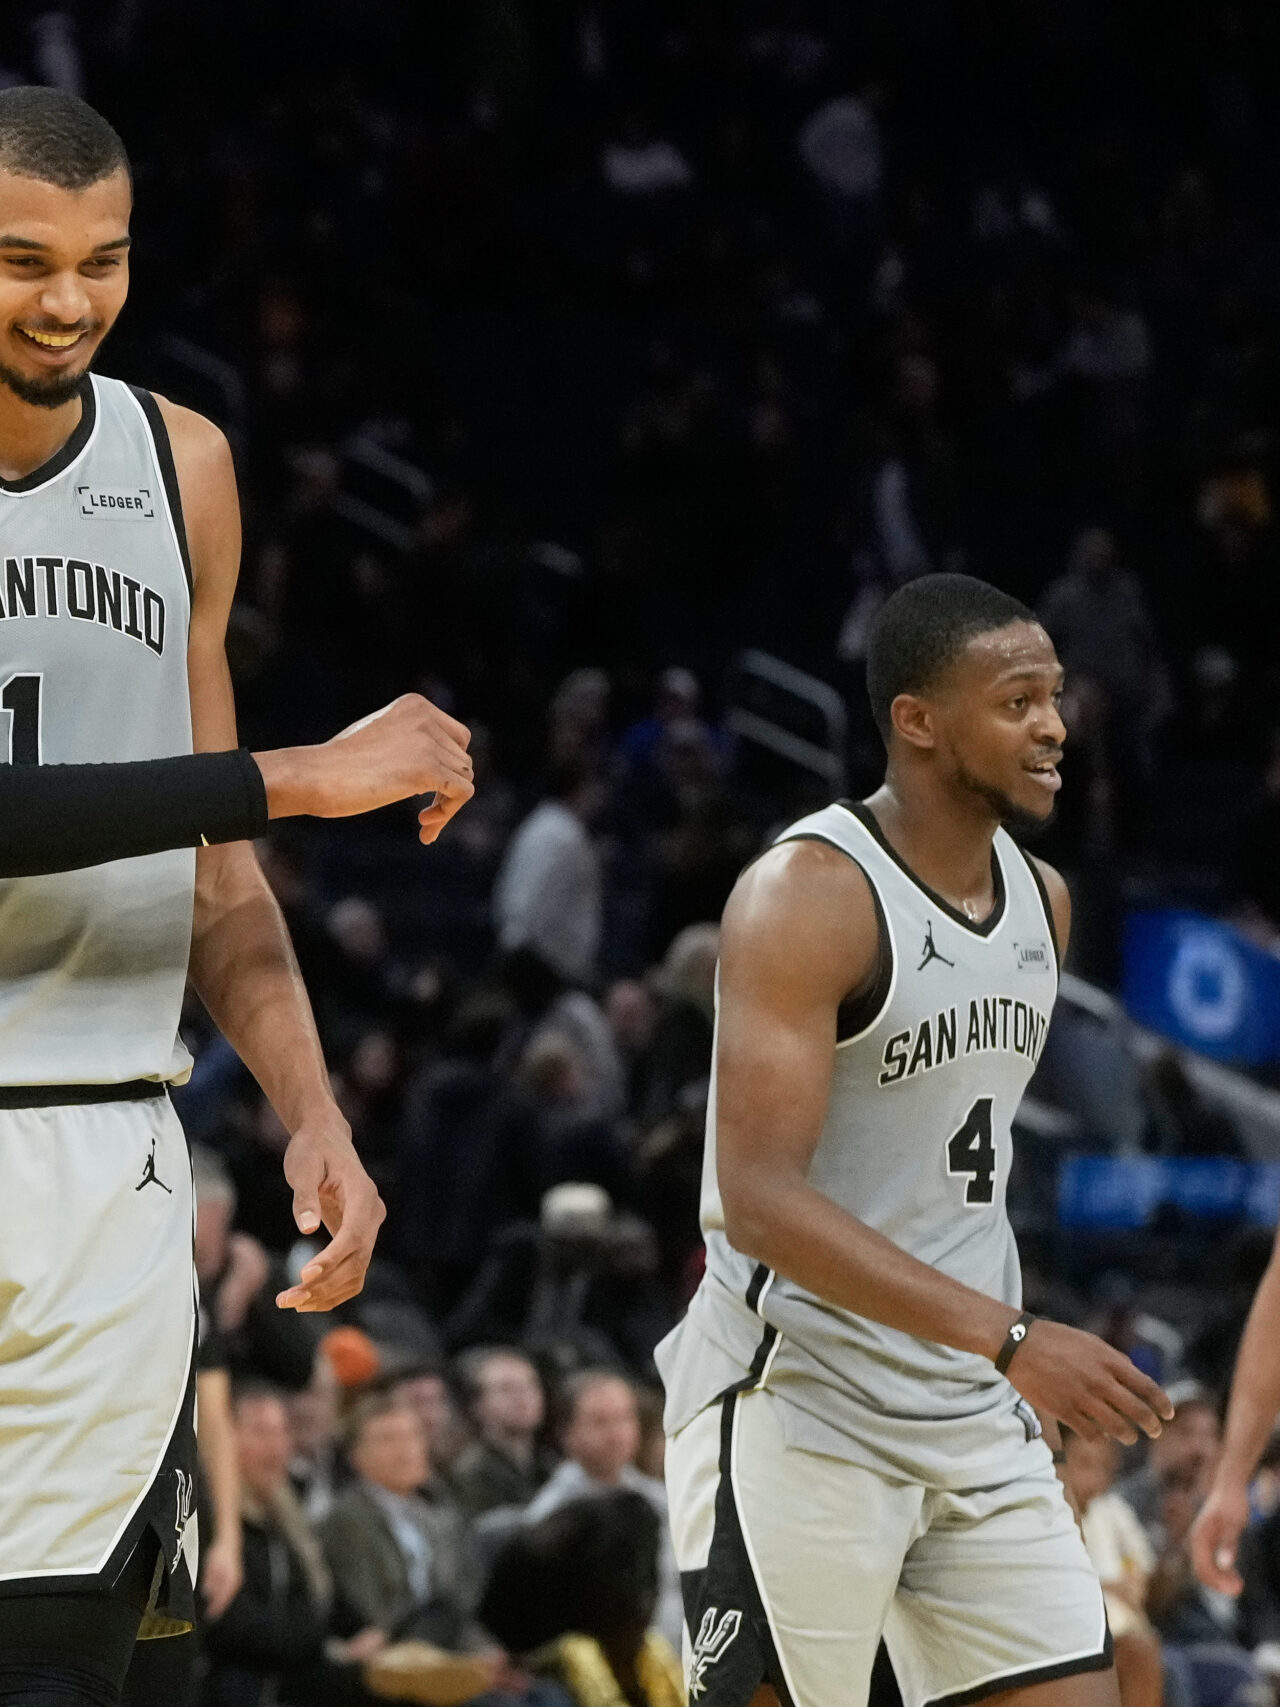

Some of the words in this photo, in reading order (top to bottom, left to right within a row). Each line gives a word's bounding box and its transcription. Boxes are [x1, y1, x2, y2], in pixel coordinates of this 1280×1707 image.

[89, 493, 144, 511] LEDGER
[0, 672, 44, 767] 1
[877, 1003, 959, 1089] SAN
[945, 1093, 998, 1208] 4
